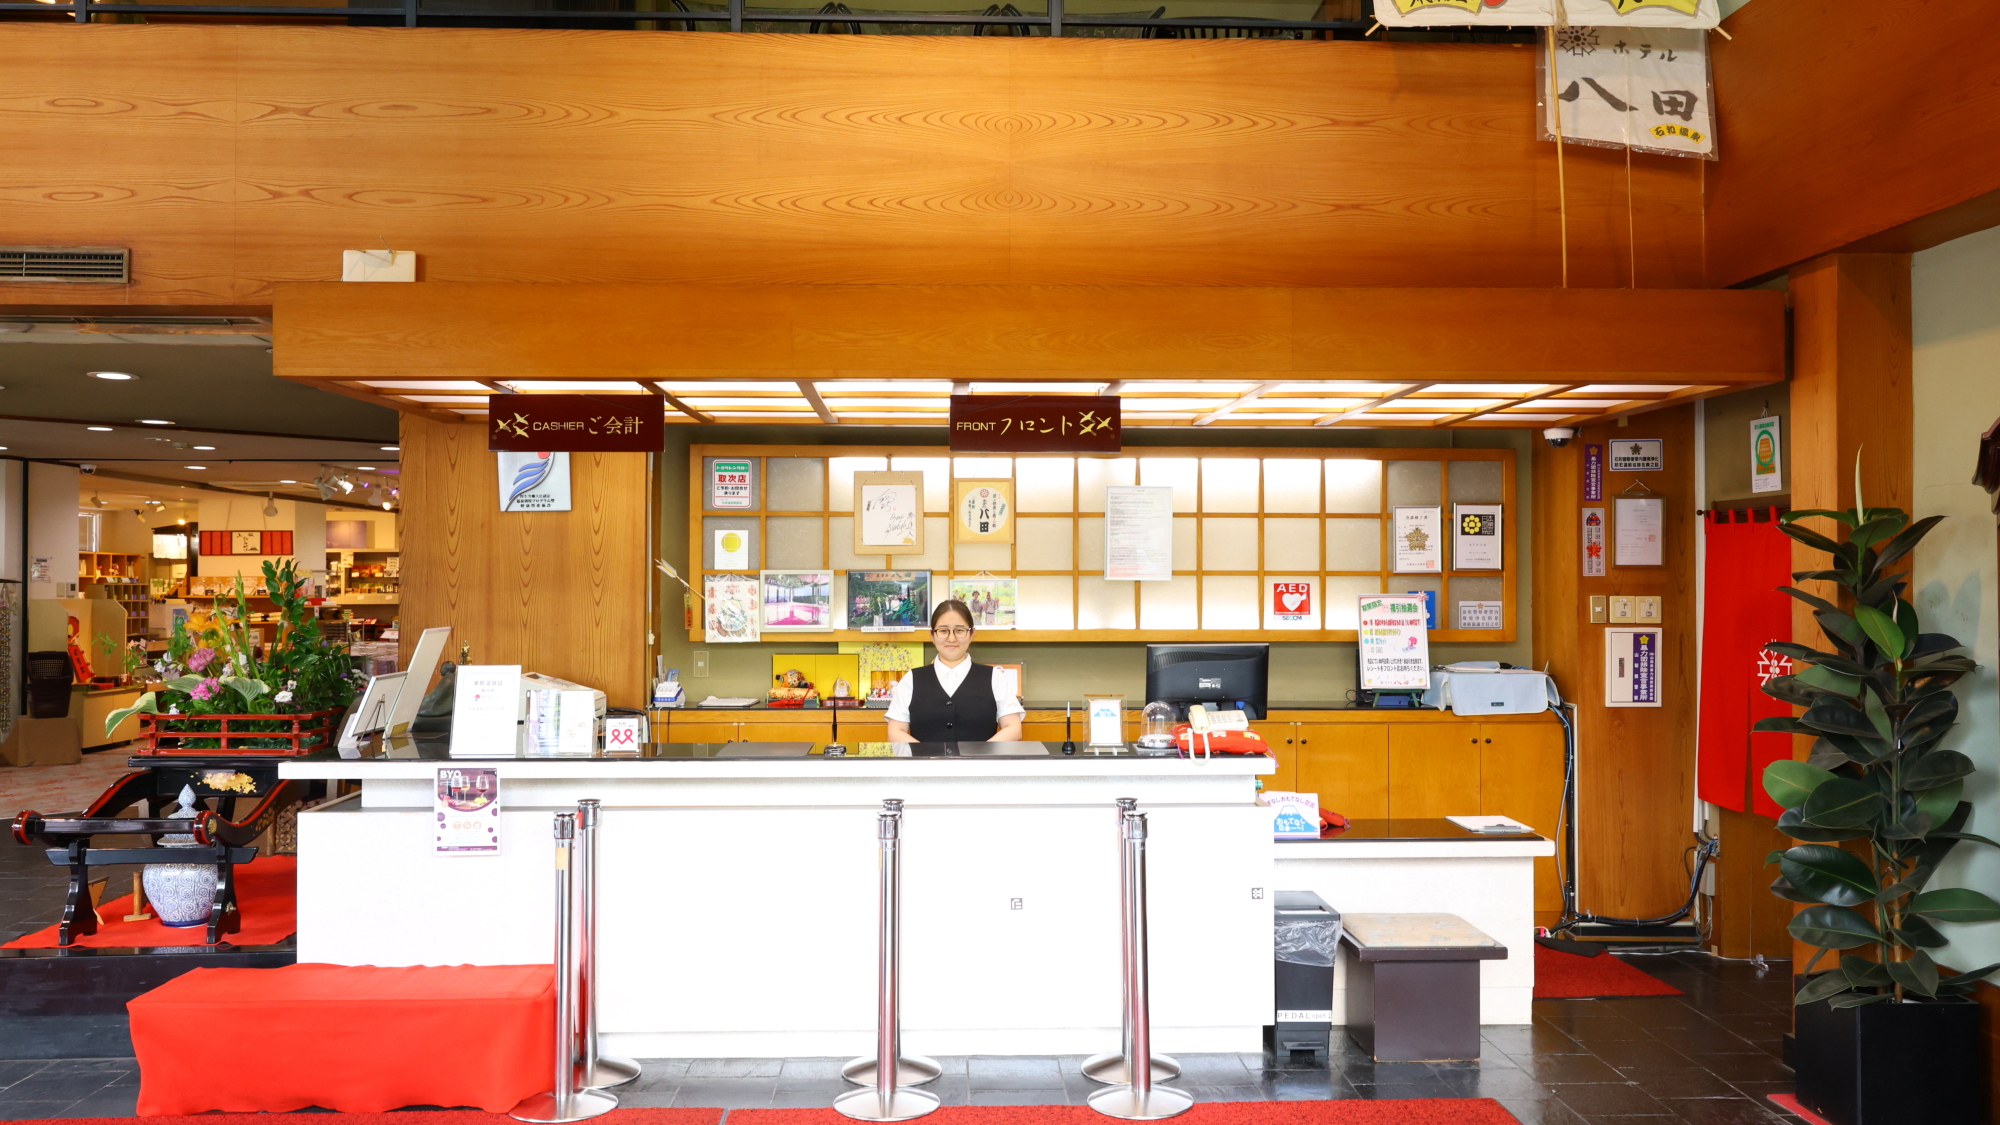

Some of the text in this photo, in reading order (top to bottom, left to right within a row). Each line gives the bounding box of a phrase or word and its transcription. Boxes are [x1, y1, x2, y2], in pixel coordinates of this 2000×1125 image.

[1612, 40, 1679, 63] ホテル
[1557, 76, 1699, 122] 八田
[1653, 125, 1702, 143] 石和温泉
[532, 415, 644, 435] CASHIER ご会計
[956, 414, 1073, 437] FRONT フロント
[717, 474, 747, 483] 取次店
[979, 509, 990, 533] 八田
[1276, 583, 1308, 593] AED
[1640, 644, 1649, 701] 暴力団排除宣言事業所
[440, 769, 462, 779] BYO
[1276, 817, 1306, 826] おもてなし
[1277, 1012, 1311, 1020] PEDAL
